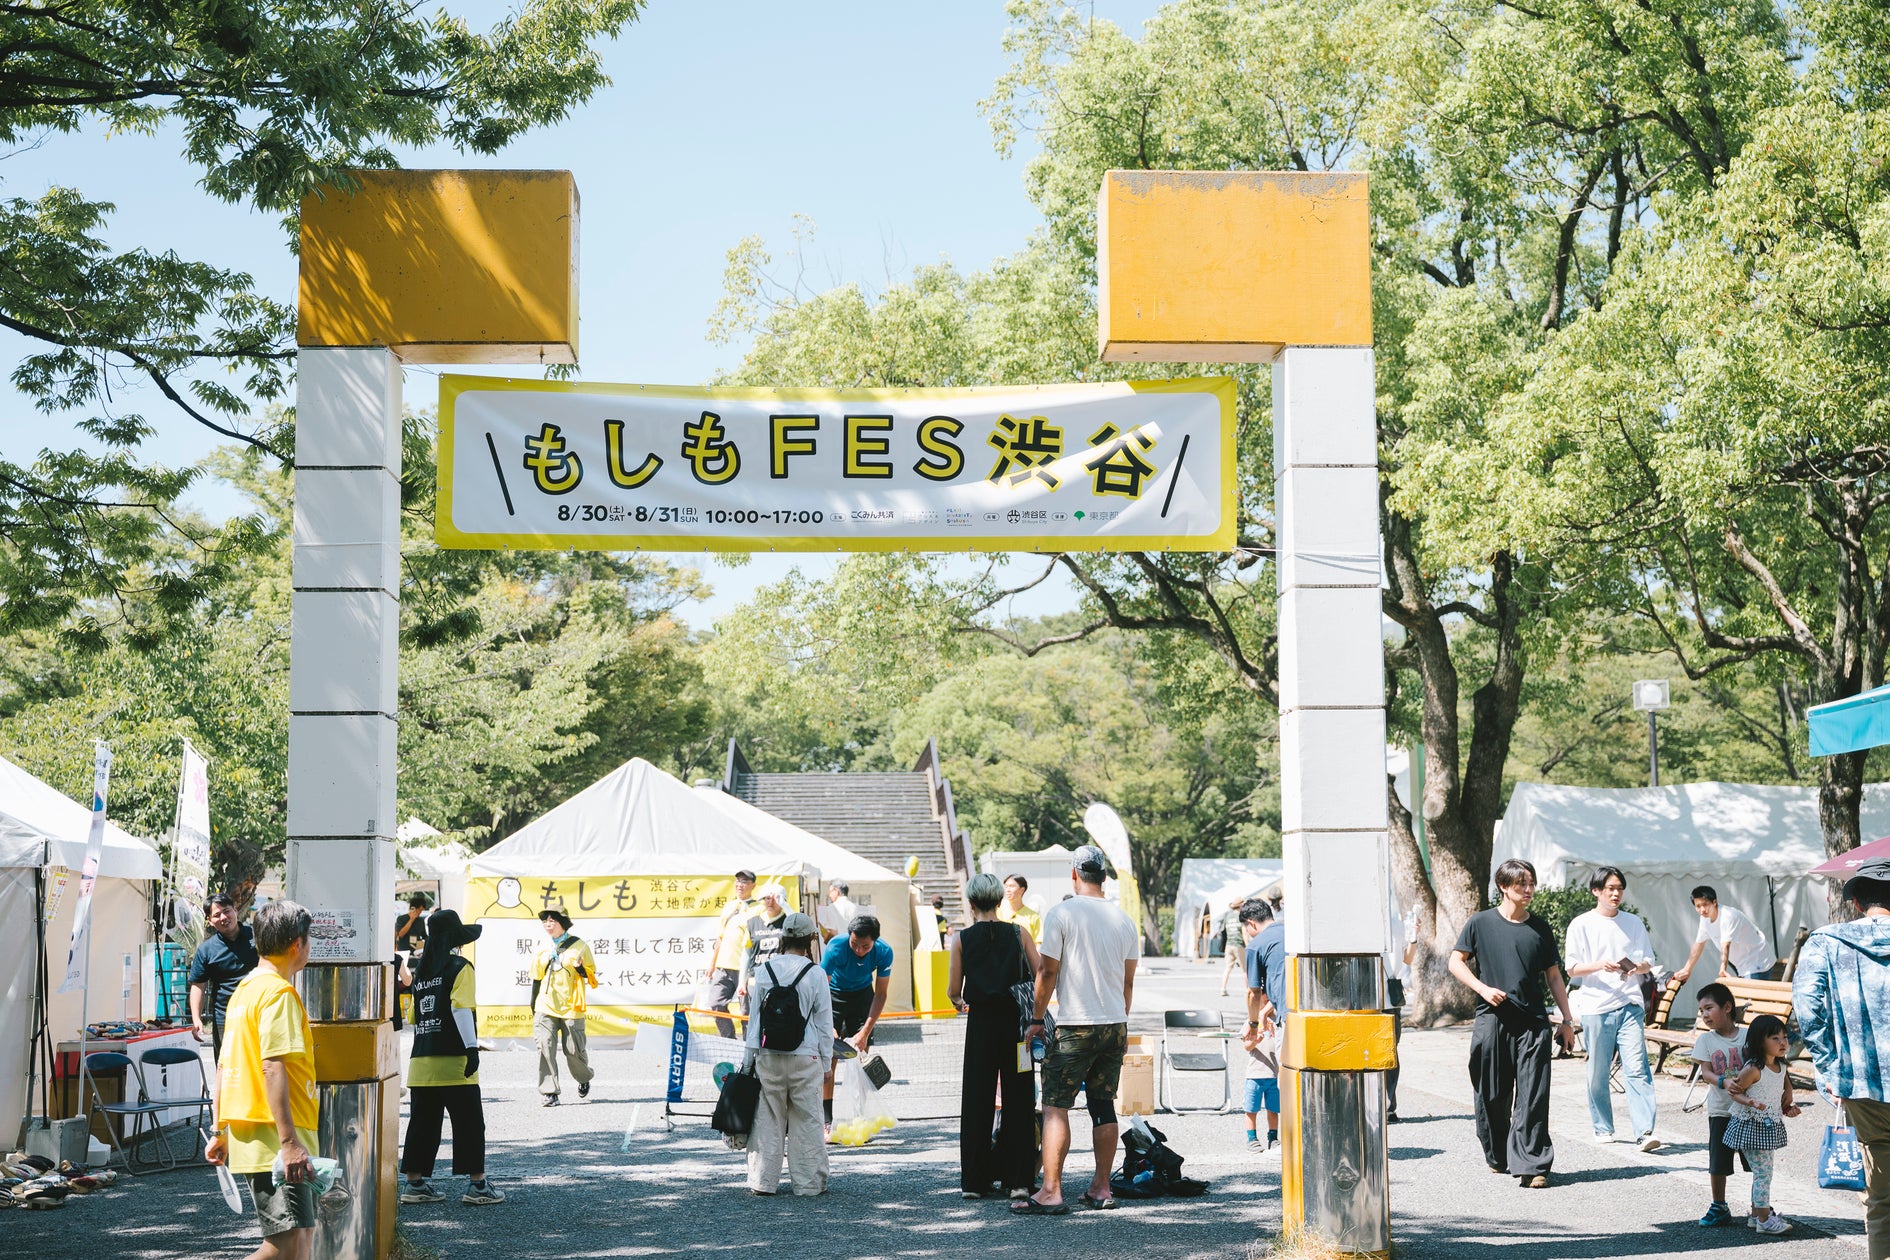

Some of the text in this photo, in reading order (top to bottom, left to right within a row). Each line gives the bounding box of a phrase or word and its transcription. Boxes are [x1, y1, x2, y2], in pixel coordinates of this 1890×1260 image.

[1021, 510, 1048, 519] 渋谷区
[1088, 510, 1120, 521] 東京都
[539, 879, 637, 911] もしも
[650, 896, 738, 909] 大地震が起
[487, 1014, 527, 1022] MOSHIMO
[670, 1031, 685, 1087] SPORT
